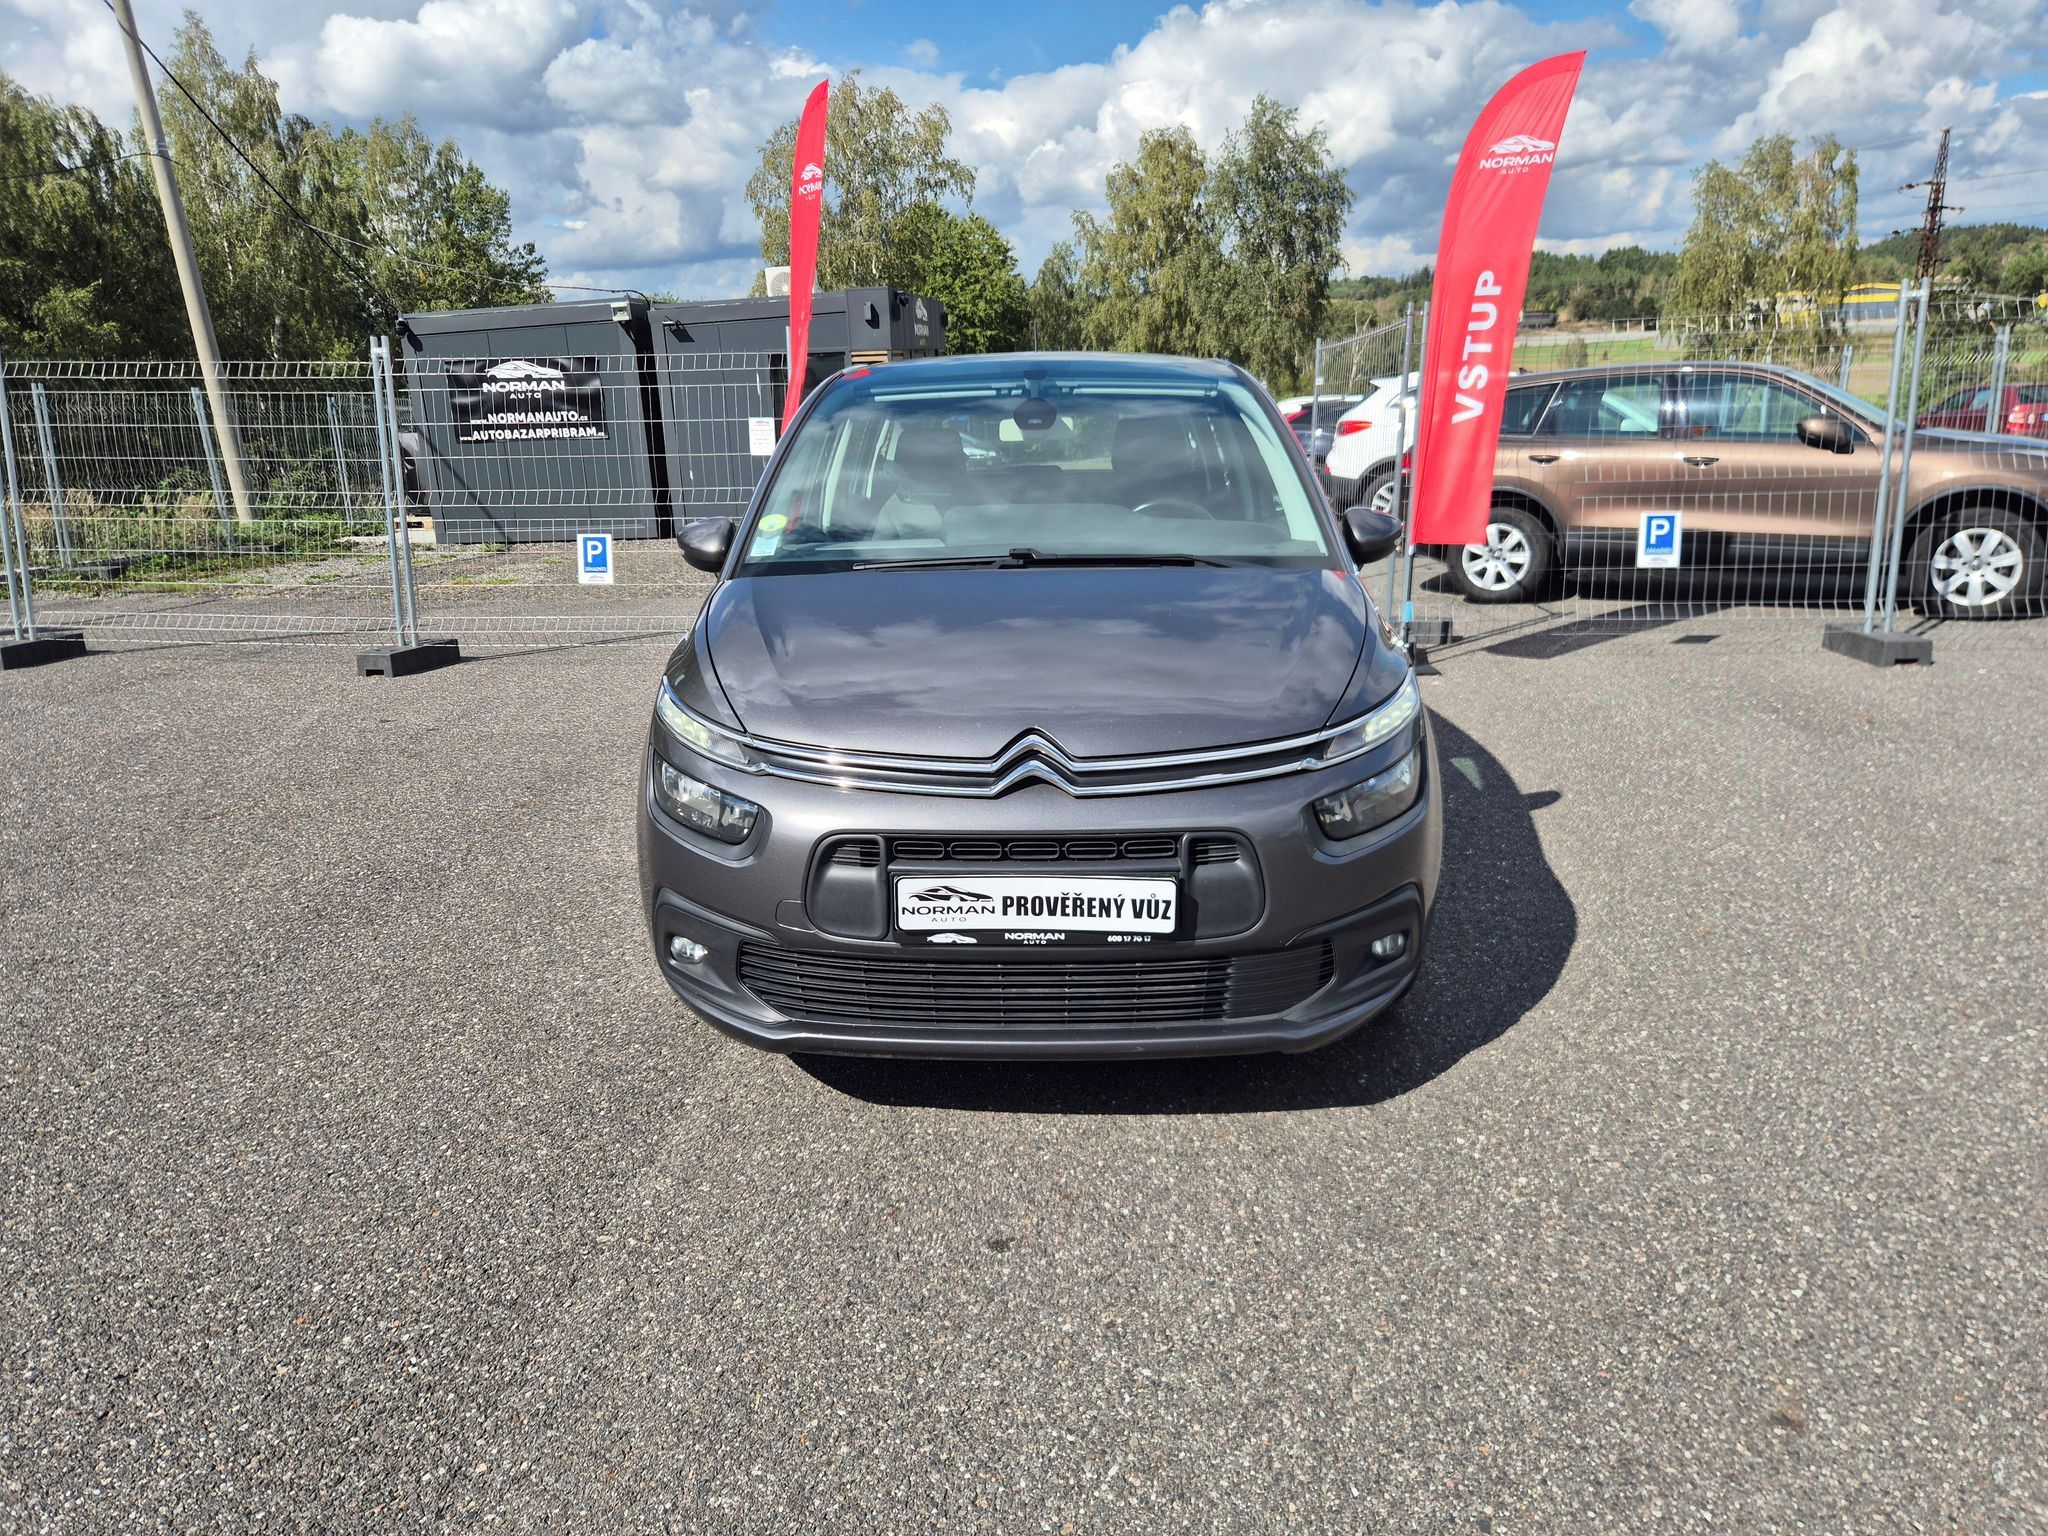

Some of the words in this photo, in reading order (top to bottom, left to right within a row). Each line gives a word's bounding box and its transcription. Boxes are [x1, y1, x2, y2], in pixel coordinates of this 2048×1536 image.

[1479, 153, 1554, 170] NORMAN
[1501, 167, 1529, 175] AUTO
[1451, 270, 1502, 424] VSTUP
[482, 380, 565, 392] NORMAN
[1650, 518, 1670, 544] P
[587, 541, 602, 563] P
[902, 906, 995, 915] NORMAN
[1002, 892, 1125, 918] PROVĚŘENÝ
[1131, 893, 1172, 920] VŮZ
